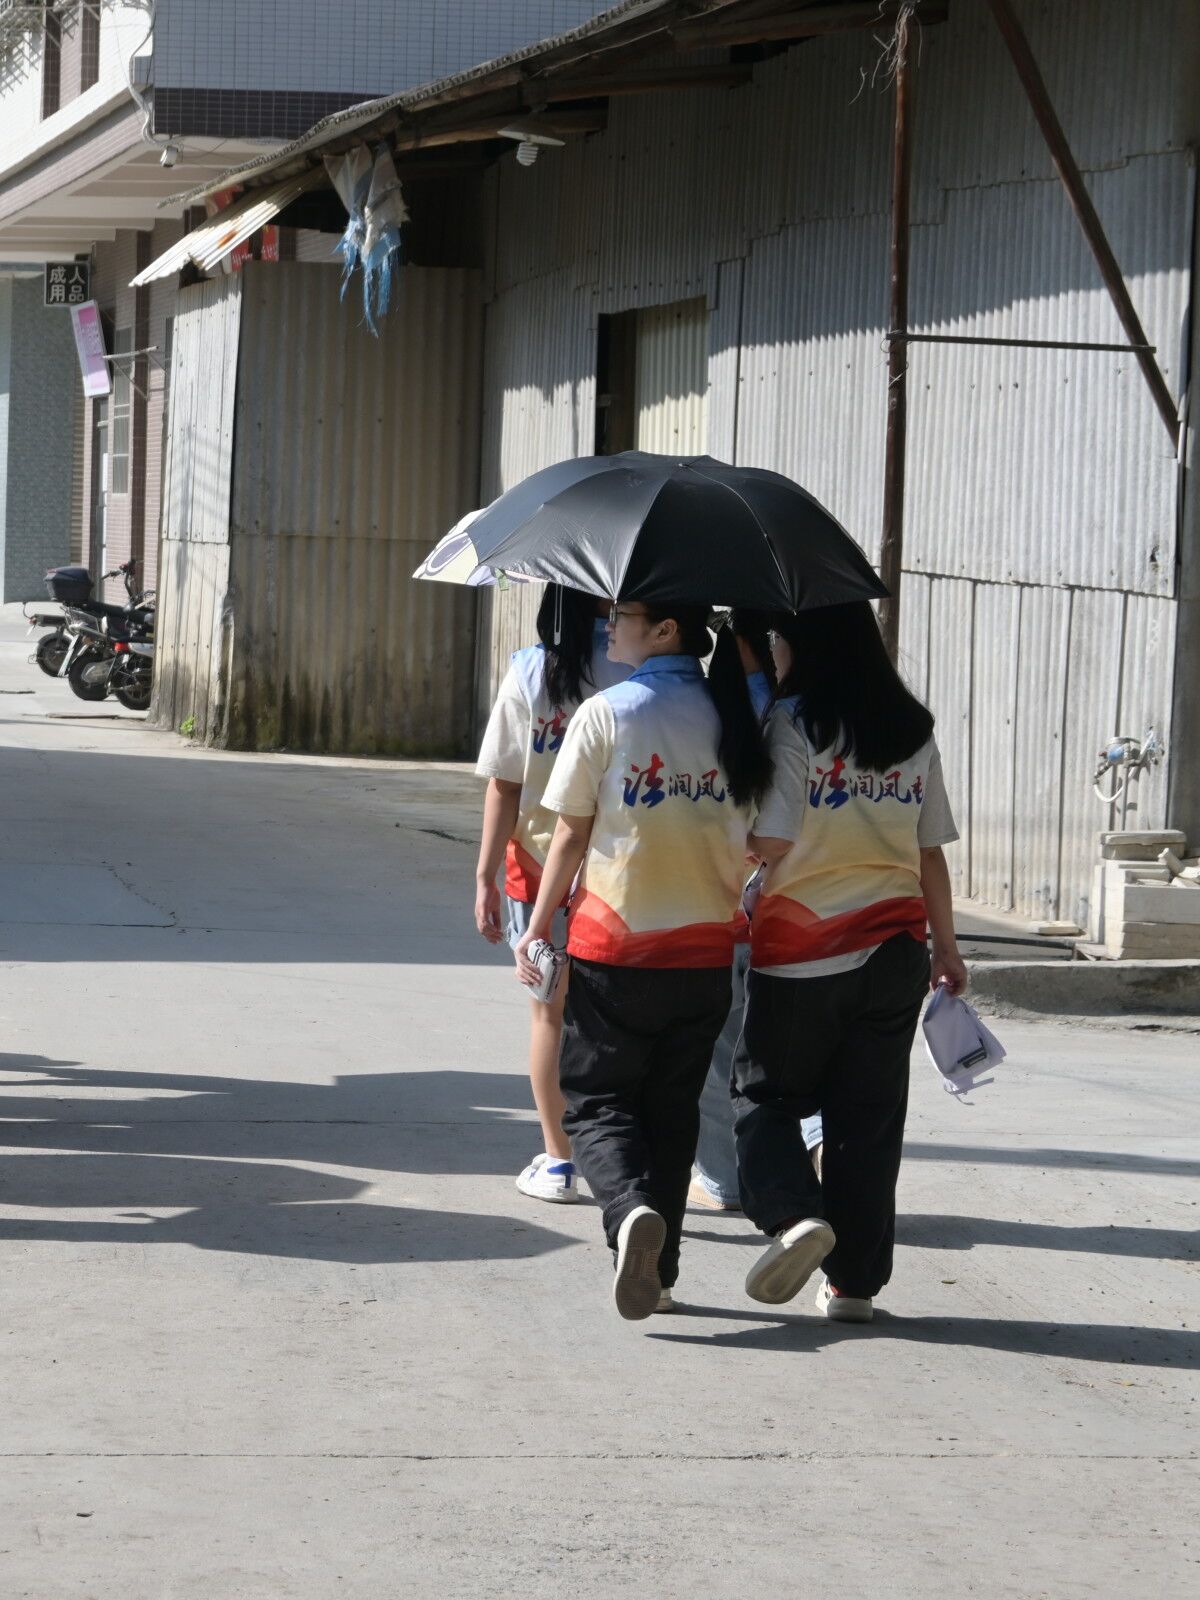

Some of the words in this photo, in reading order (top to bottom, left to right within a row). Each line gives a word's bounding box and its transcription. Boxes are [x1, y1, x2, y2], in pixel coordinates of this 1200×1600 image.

[49, 265, 86, 284] 成人
[49, 284, 85, 303] 用品
[623, 753, 736, 808] 法润凤
